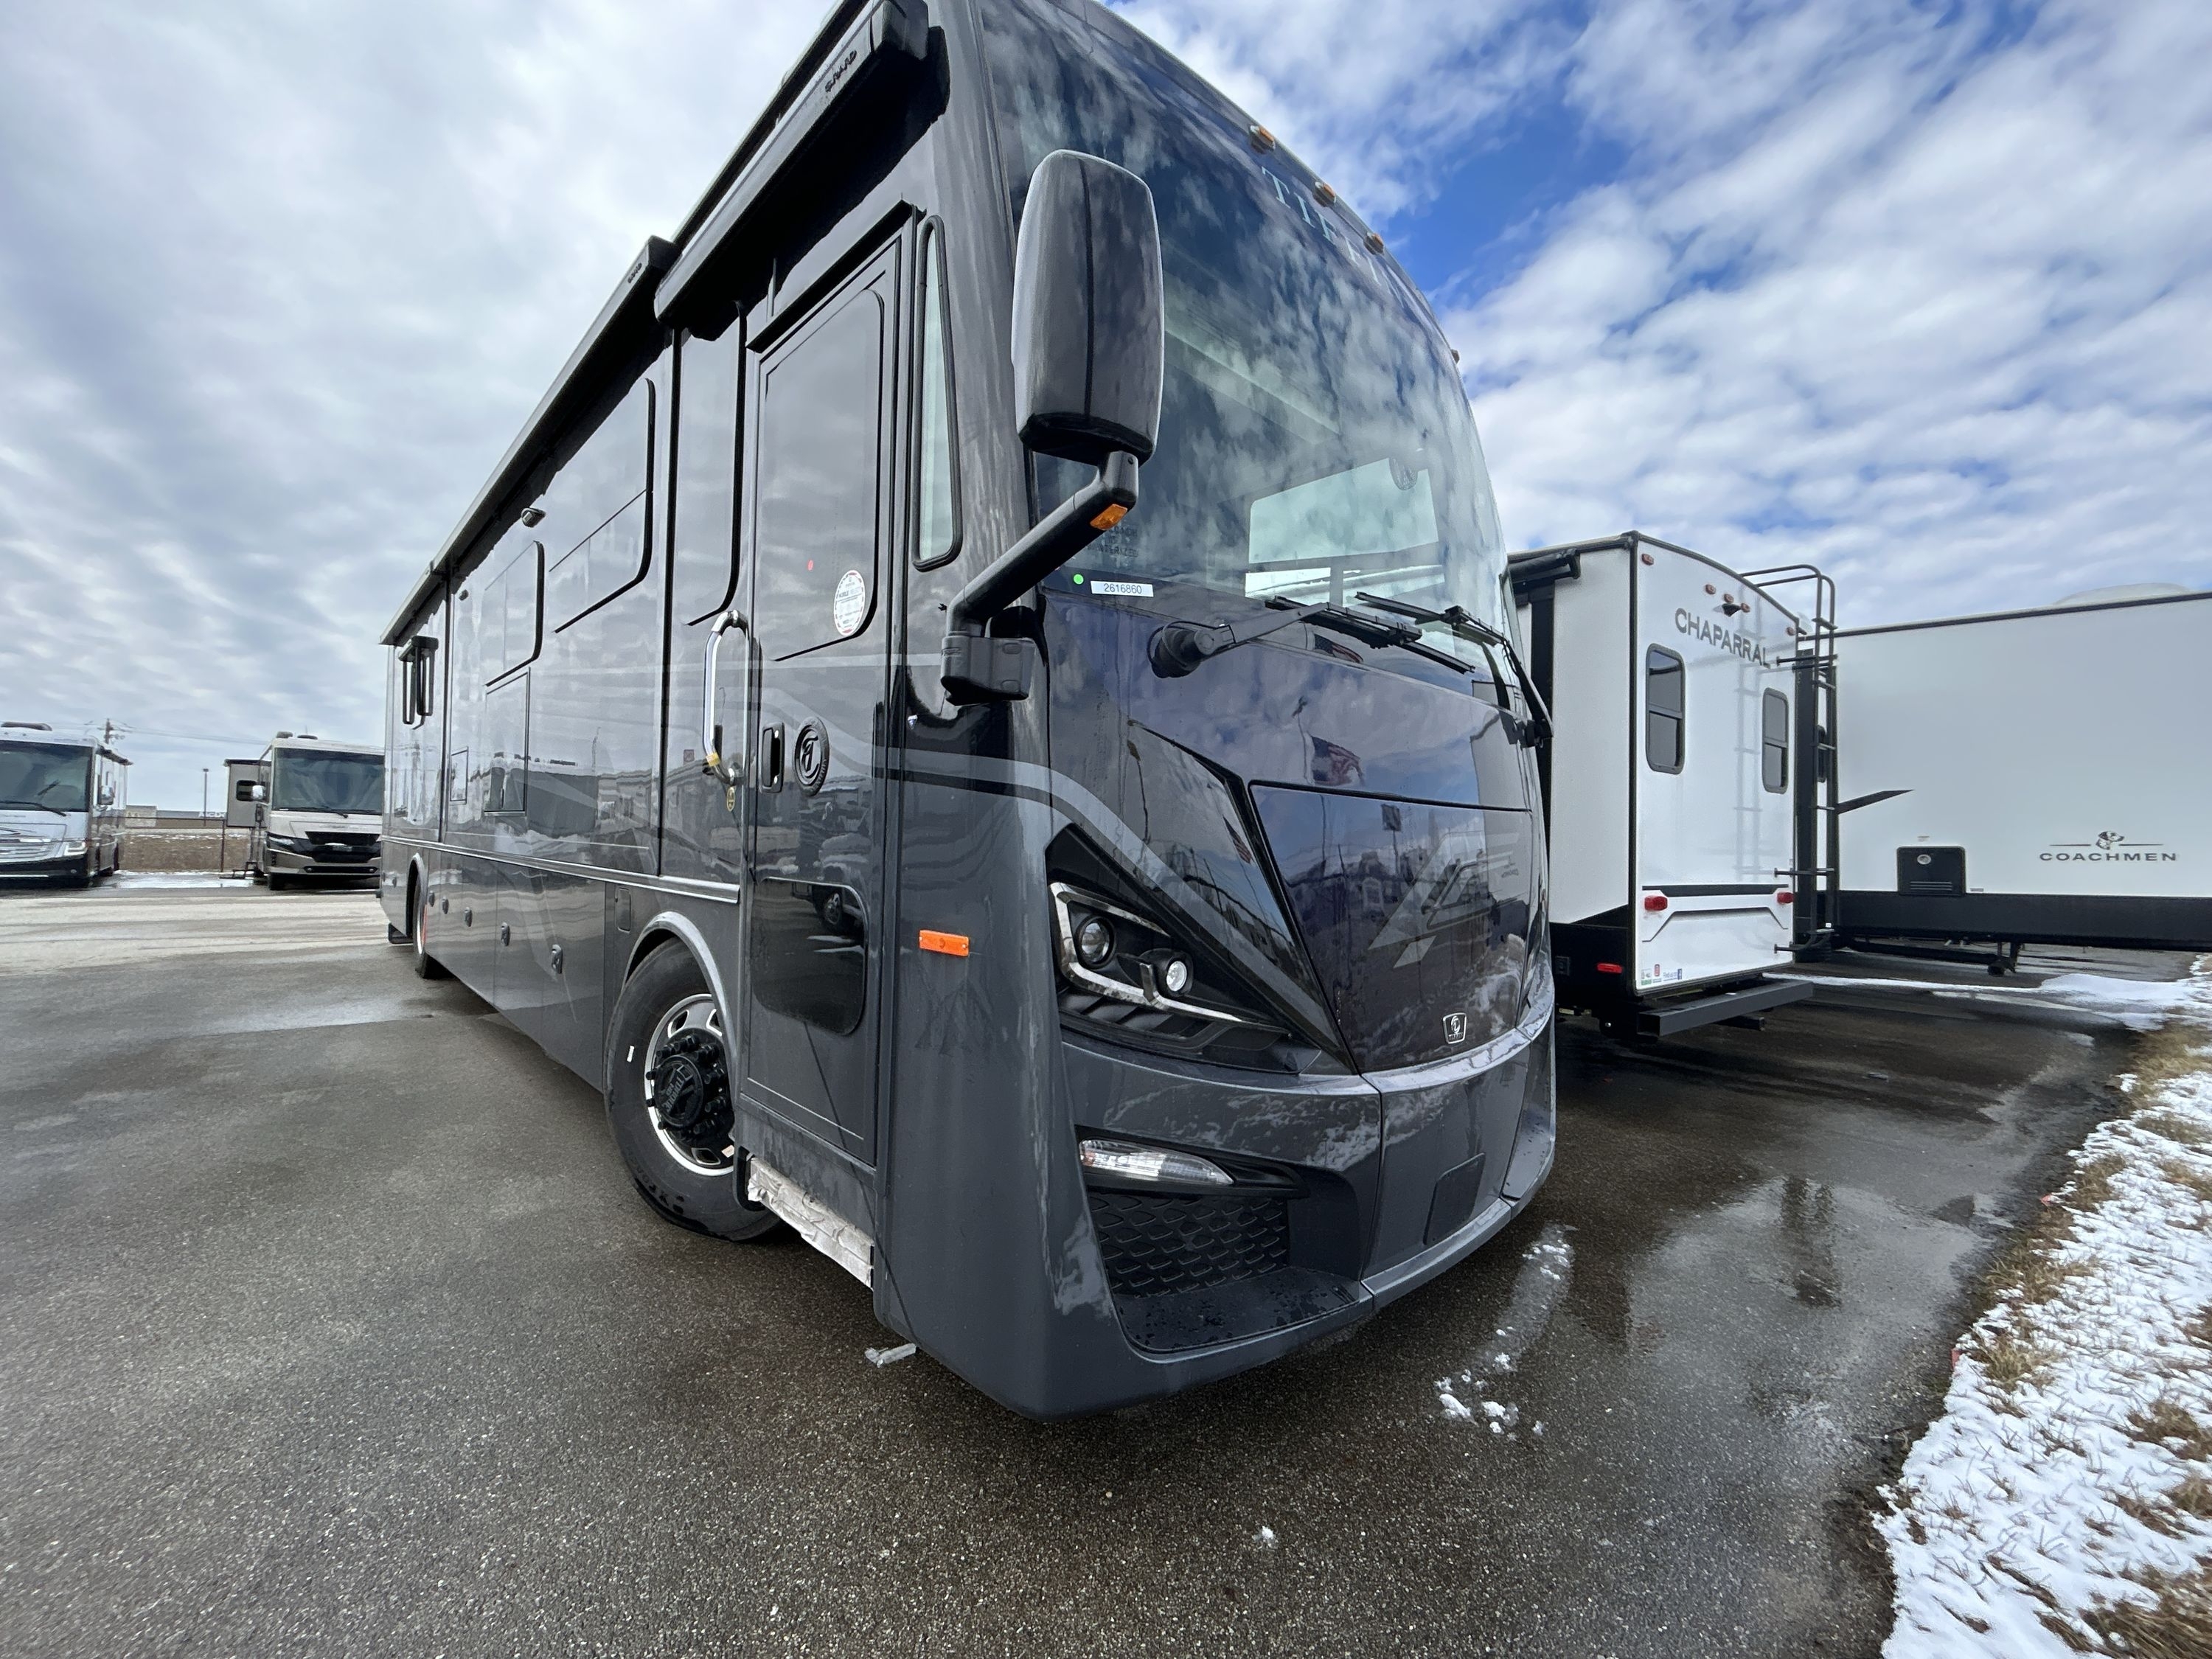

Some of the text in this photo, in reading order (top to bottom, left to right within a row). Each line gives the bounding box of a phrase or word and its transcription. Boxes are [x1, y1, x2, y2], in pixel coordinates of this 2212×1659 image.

[1103, 583, 1142, 594] 2616860
[1674, 608, 1771, 669] CHAPARRAL
[2039, 852, 2177, 861] COACHMEN
